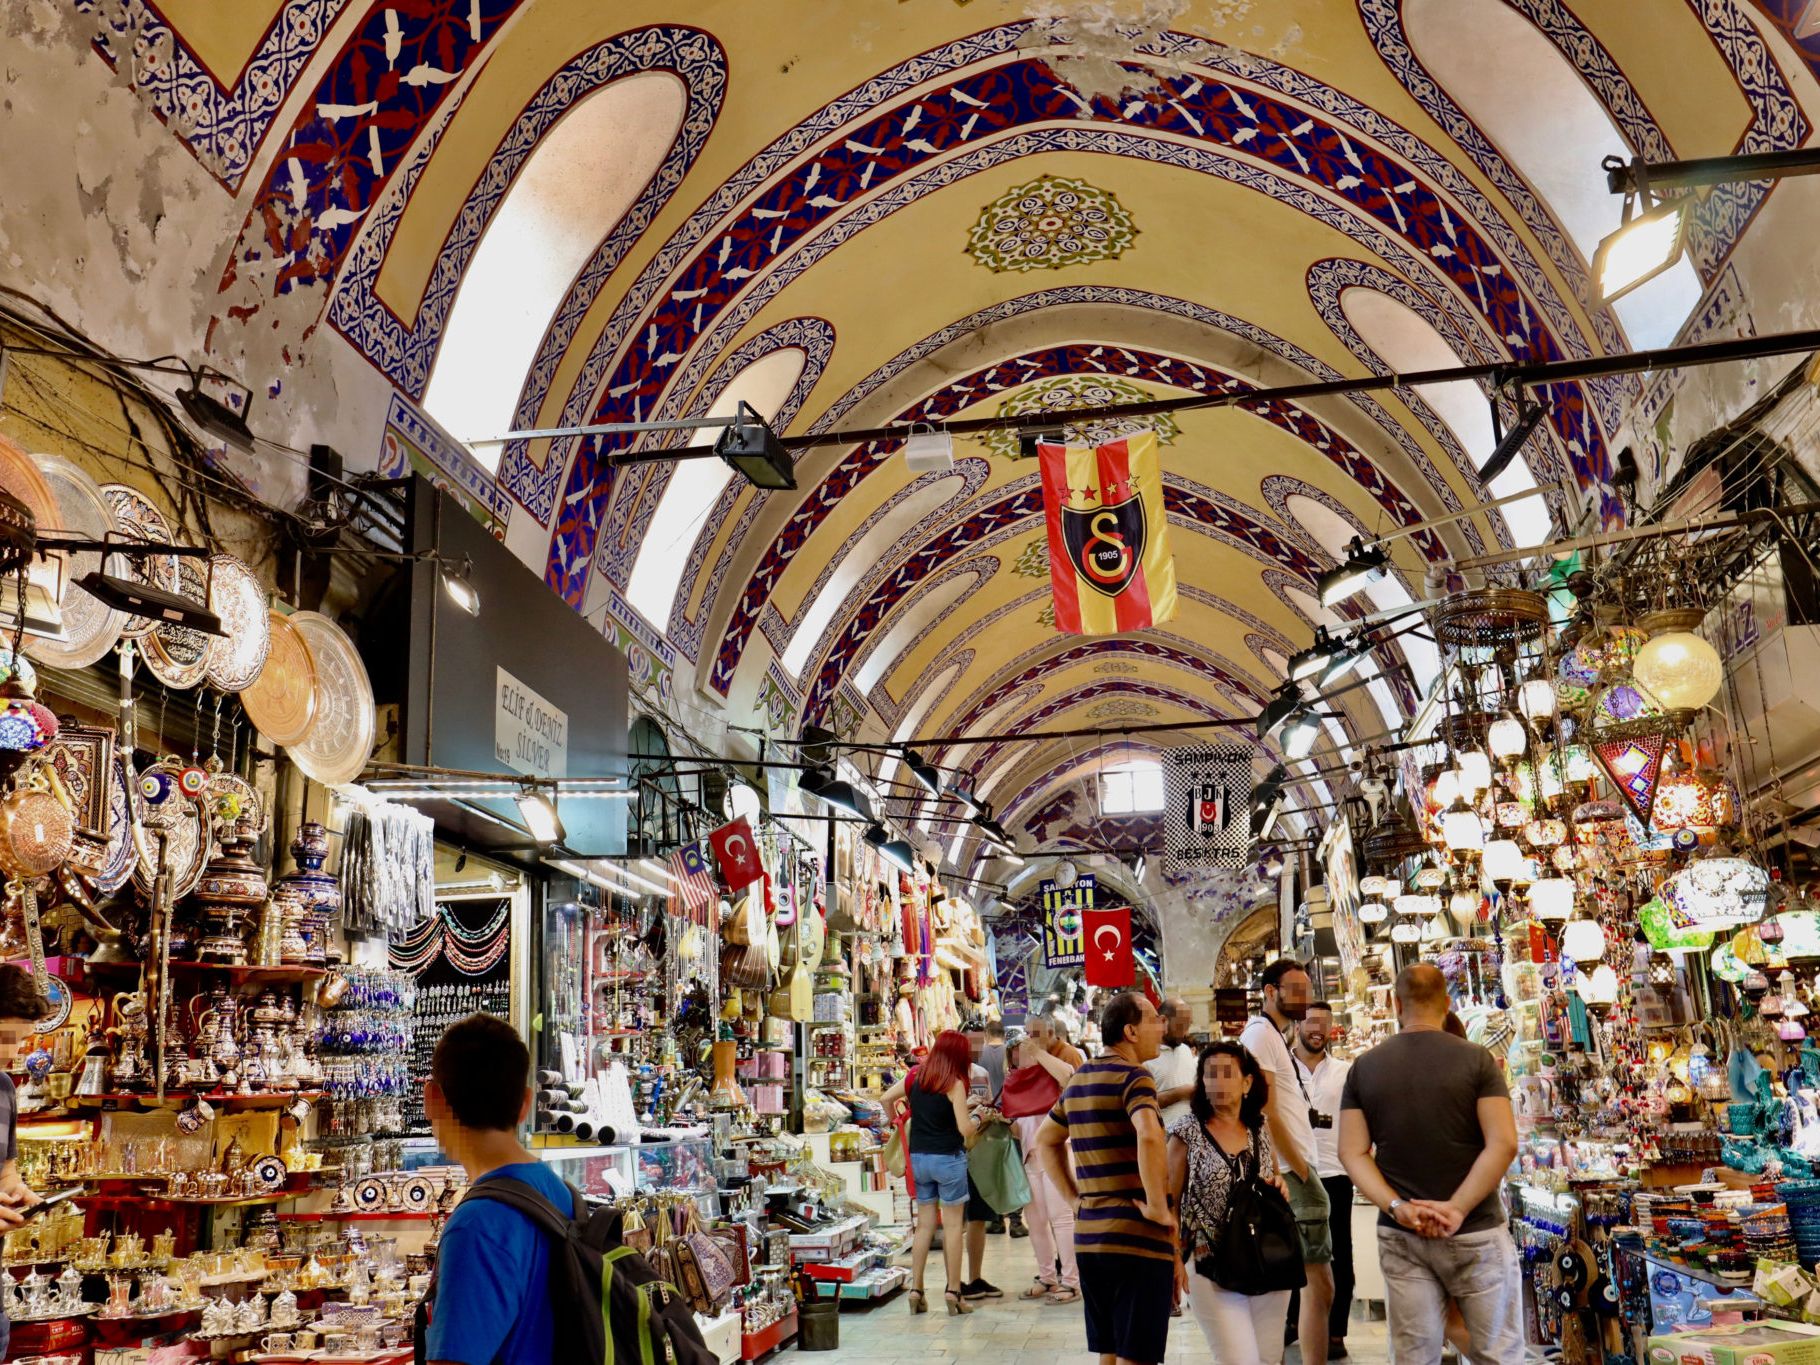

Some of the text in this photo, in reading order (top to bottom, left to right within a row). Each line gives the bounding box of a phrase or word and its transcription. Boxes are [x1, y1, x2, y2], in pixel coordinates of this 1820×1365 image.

[1098, 550, 1118, 560] 1905
[502, 685, 526, 720] ELİF
[1195, 787, 1222, 800] BJK
[1198, 822, 1220, 832] 1903
